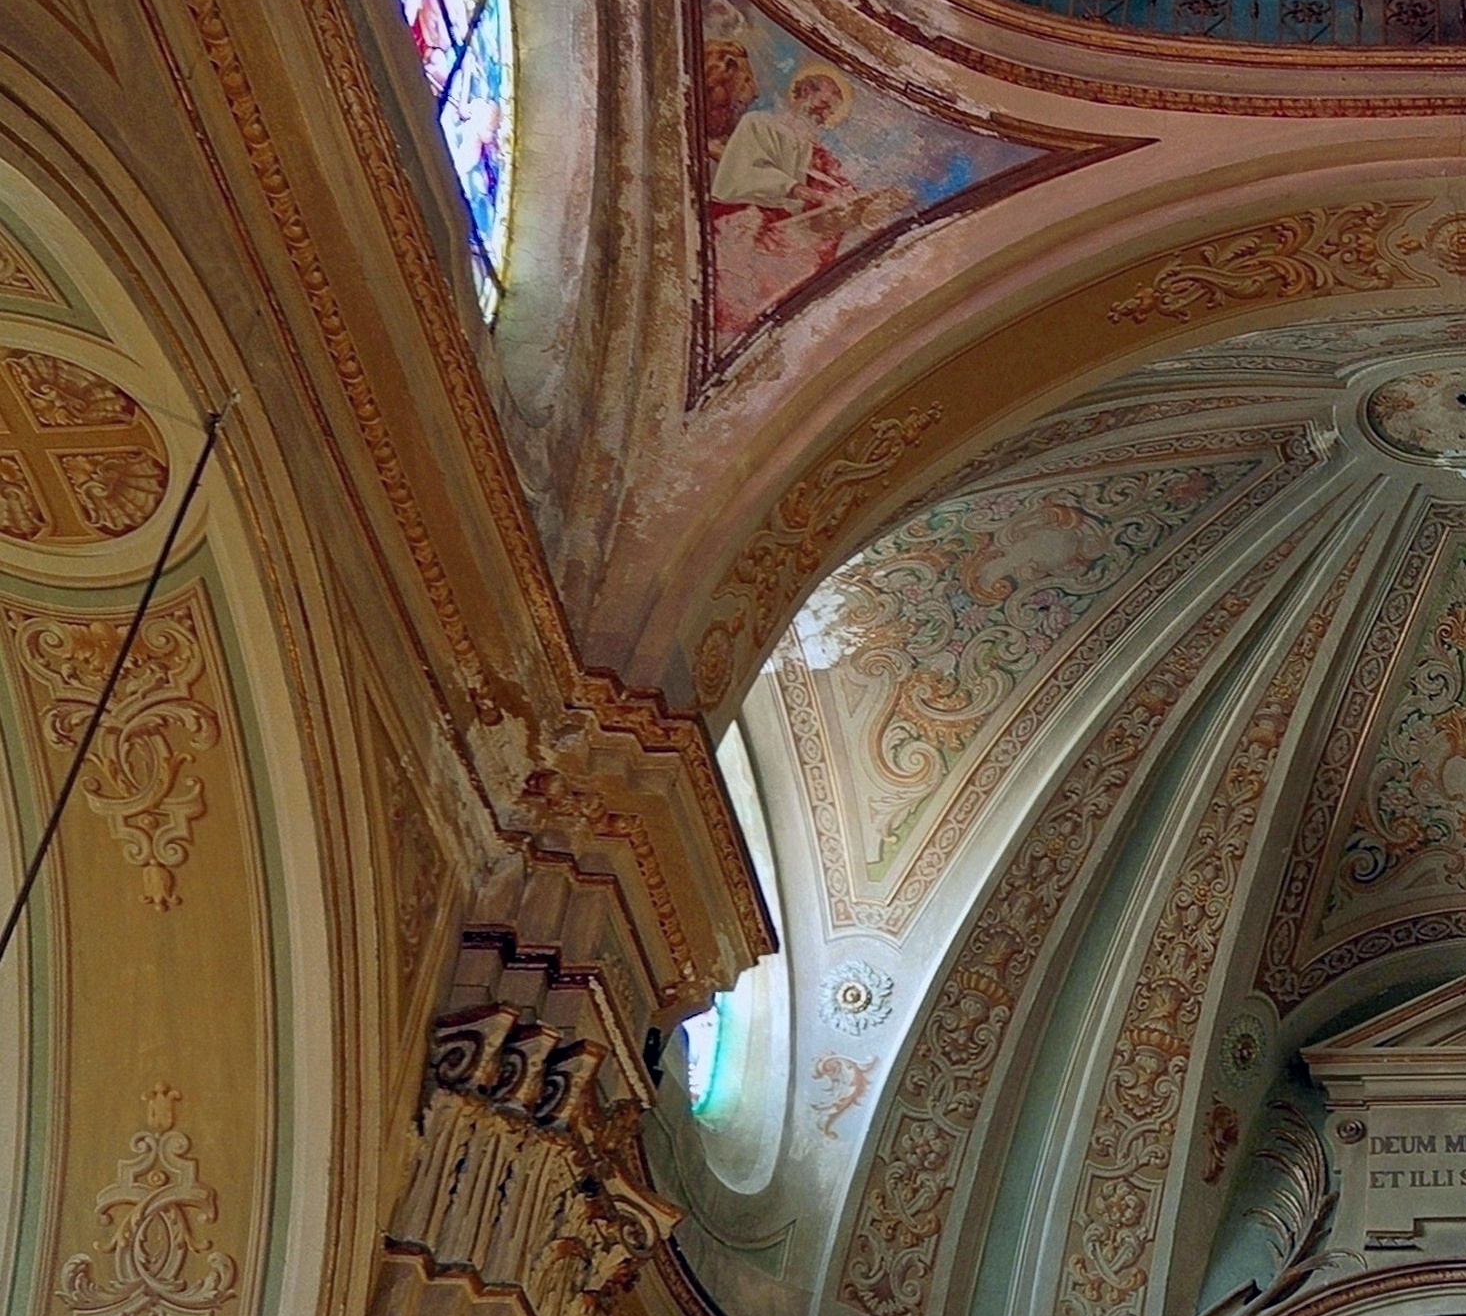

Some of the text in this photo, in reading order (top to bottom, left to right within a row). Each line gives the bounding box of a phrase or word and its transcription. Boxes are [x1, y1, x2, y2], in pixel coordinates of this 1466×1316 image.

[1370, 1134, 1436, 1156] DEUM
[1370, 1170, 1406, 1189] ET
[1410, 1169, 1455, 1188] ILLI
